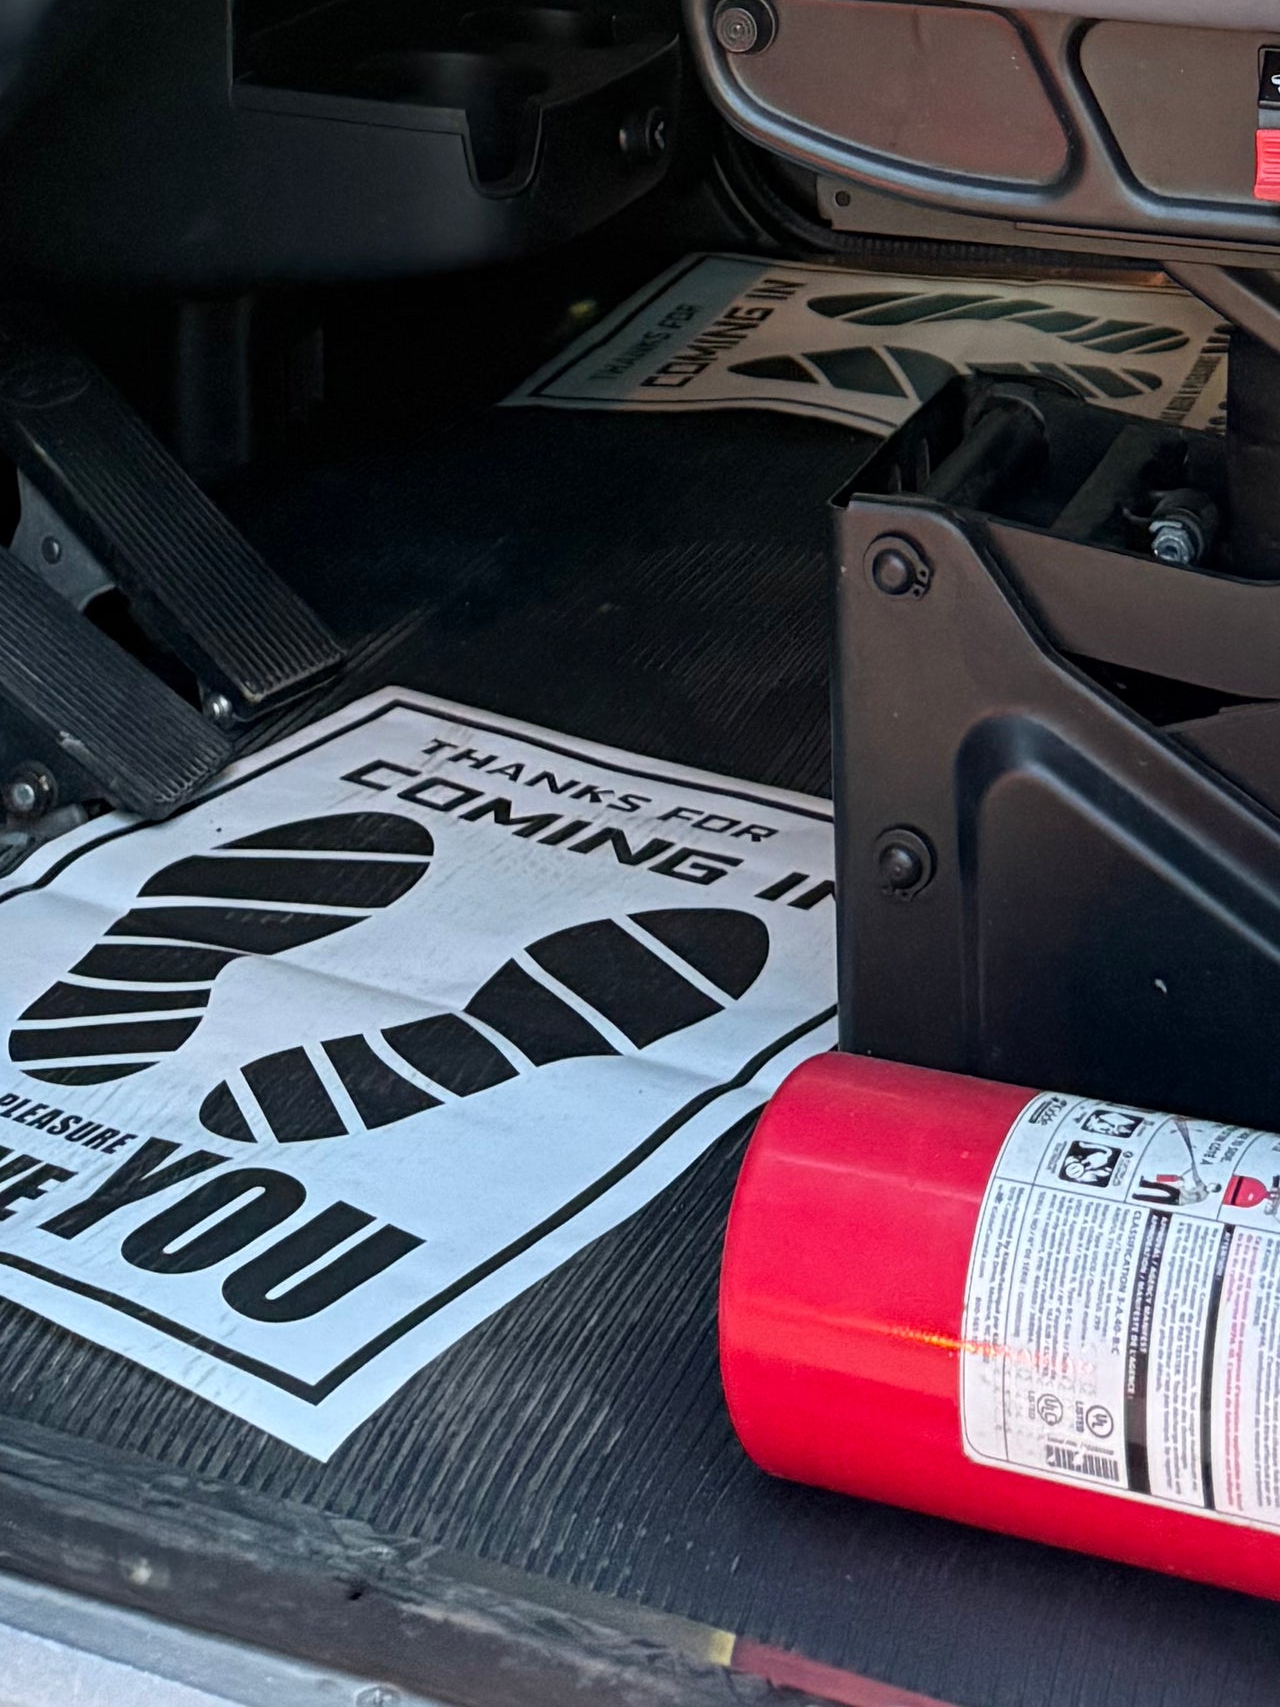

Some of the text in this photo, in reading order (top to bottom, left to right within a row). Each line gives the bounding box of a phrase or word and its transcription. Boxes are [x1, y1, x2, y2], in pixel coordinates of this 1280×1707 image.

[588, 302, 697, 382] THANKS FOR
[640, 278, 808, 388] COMING IN
[422, 738, 780, 843] THANKS FOR
[340, 759, 745, 886] COMING
[36, 1136, 427, 1325] YOU
[1005, 1186, 1024, 1239] Manufactured
[993, 1241, 1004, 1259] Park
[1117, 1209, 1141, 1294] CLASSIFICATION
[1131, 1281, 1144, 1331] MANIFESTE
[1144, 1266, 1156, 1304] AGENCY
[1129, 1334, 1137, 1347] DE
[1138, 1306, 1151, 1354] MANIFEST
[1025, 1390, 1037, 1420] LISTED
[1073, 1401, 1086, 1432] LISTED
